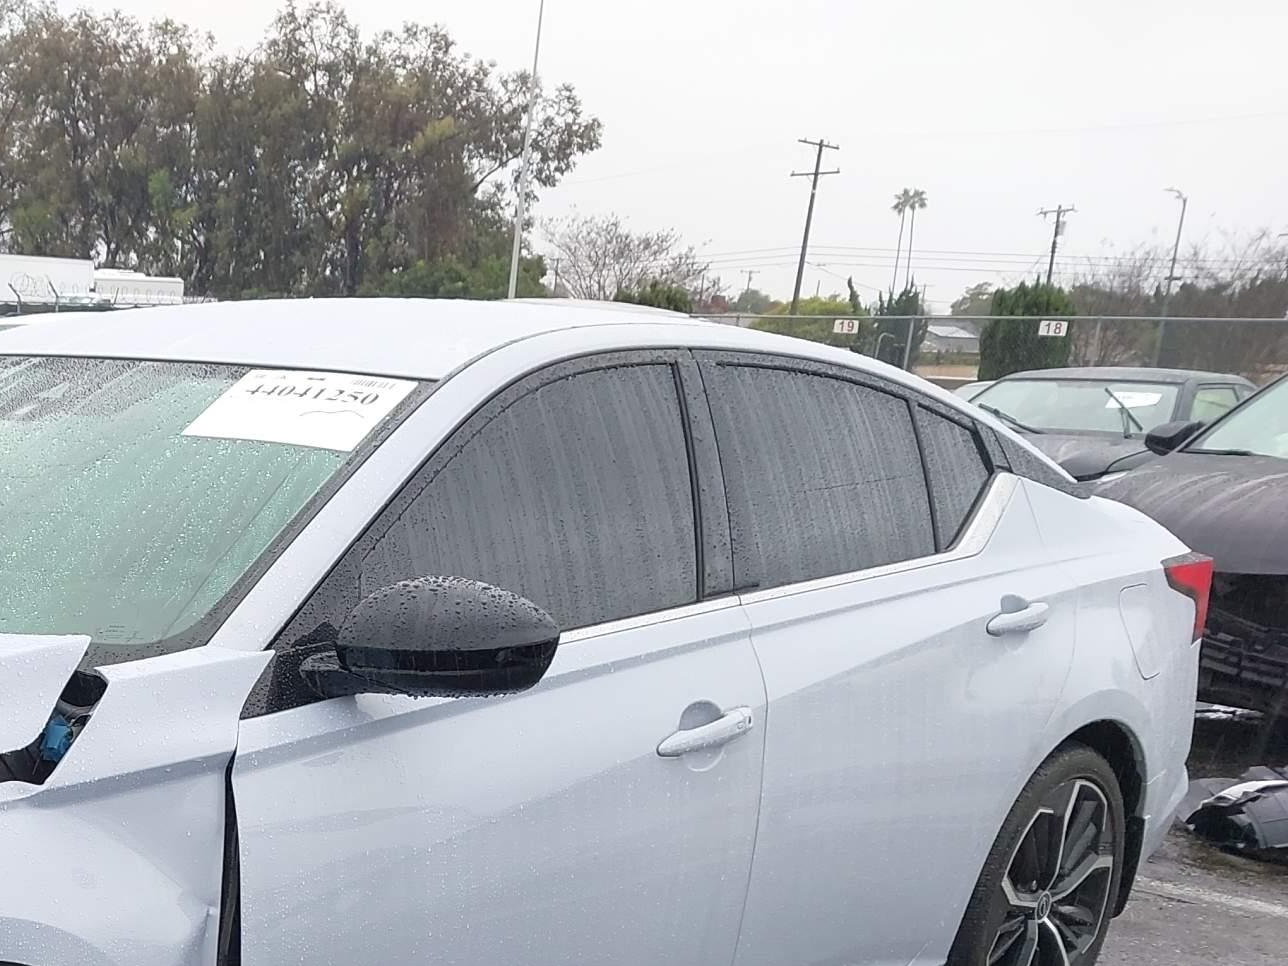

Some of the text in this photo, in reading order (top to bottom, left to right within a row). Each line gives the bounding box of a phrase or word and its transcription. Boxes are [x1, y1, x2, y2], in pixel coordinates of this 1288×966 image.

[838, 320, 855, 332] 19
[1044, 322, 1062, 334] 18
[246, 384, 381, 406] 44041250
